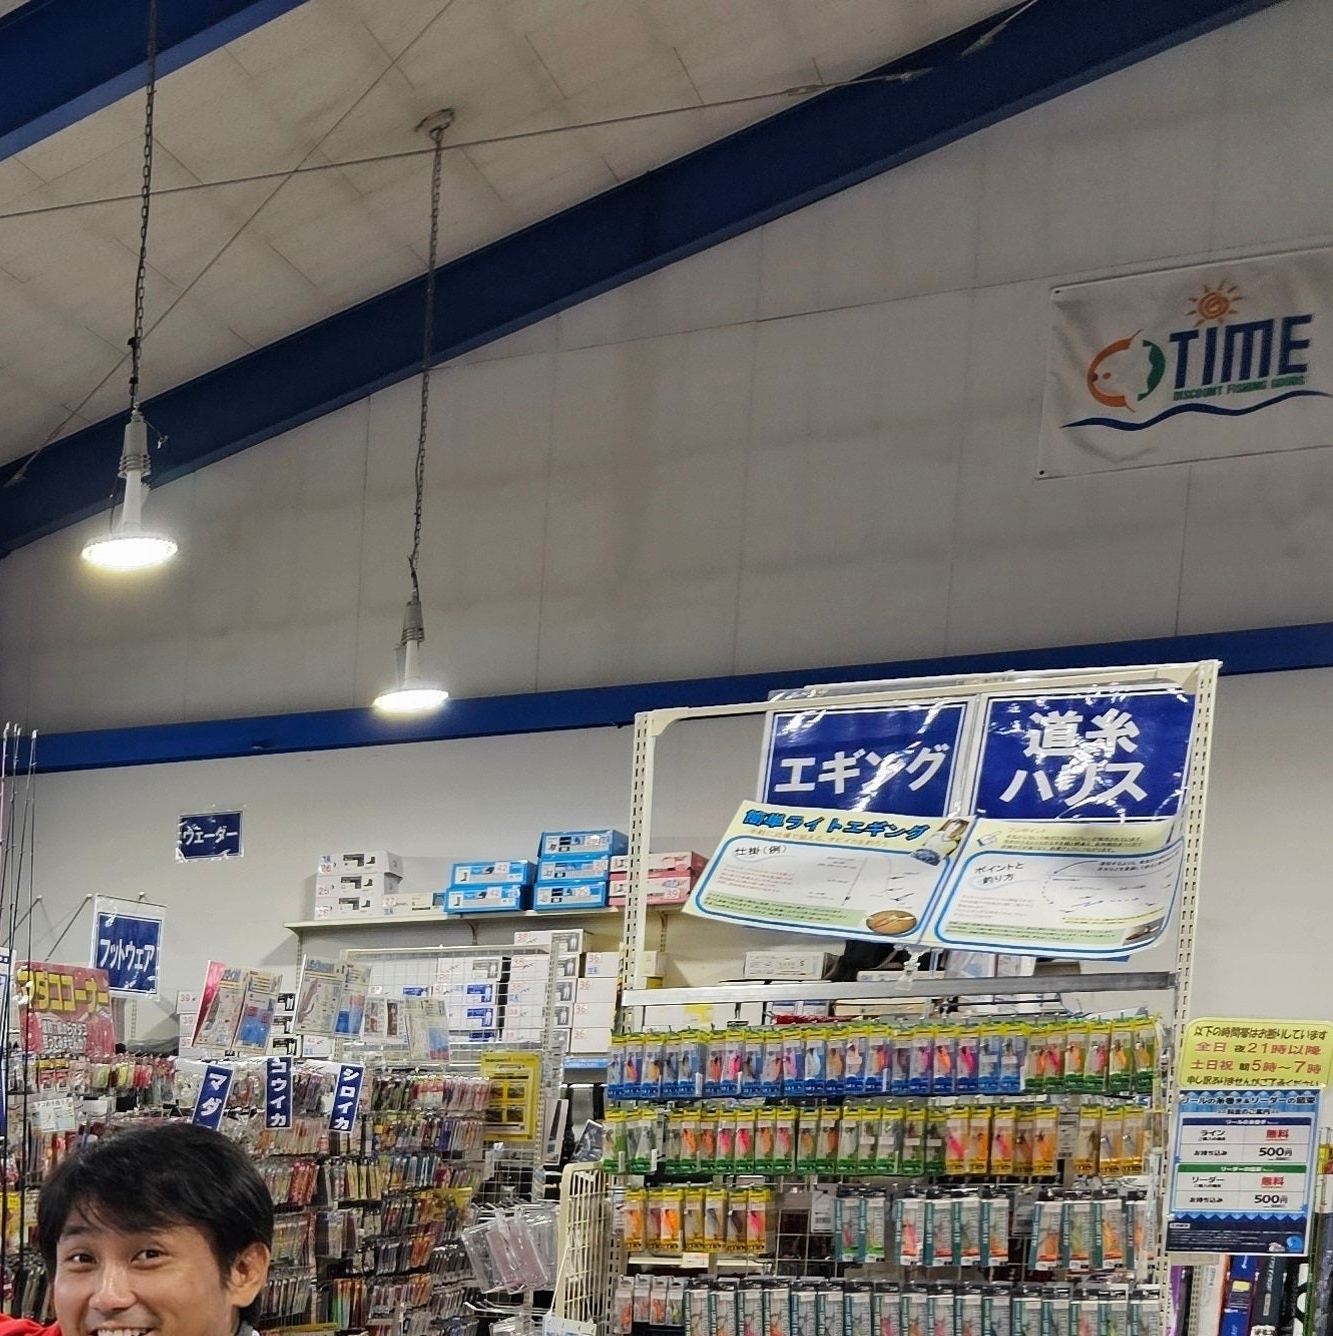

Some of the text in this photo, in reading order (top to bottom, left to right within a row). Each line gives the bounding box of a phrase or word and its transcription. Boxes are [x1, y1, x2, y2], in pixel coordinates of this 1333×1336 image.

[1169, 313, 1316, 389] TIME
[1028, 708, 1141, 760] 道糸
[774, 744, 950, 793] エギング
[999, 762, 1149, 808] ハリス
[183, 825, 238, 846] ヴェーダー
[743, 809, 931, 841] 簡単ライトエギング
[974, 862, 1025, 874] ポイントと
[983, 873, 1015, 884] 釣り方
[98, 938, 157, 974] フットウェア
[1194, 1025, 1328, 1041] 以下の時間帯はお断りしています
[1195, 1041, 1322, 1056] 全日 夜21時以降
[1190, 1059, 1234, 1071] 土日祝
[192, 1072, 228, 1129] マダ
[269, 1058, 287, 1128] コウイカ
[333, 1067, 360, 1131] シロイカ
[1200, 1129, 1289, 1139] ライン 無料
[1258, 1146, 1293, 1158] 500円
[1191, 1175, 1285, 1187] リーダー 無料
[1254, 1194, 1288, 1205] 500円
